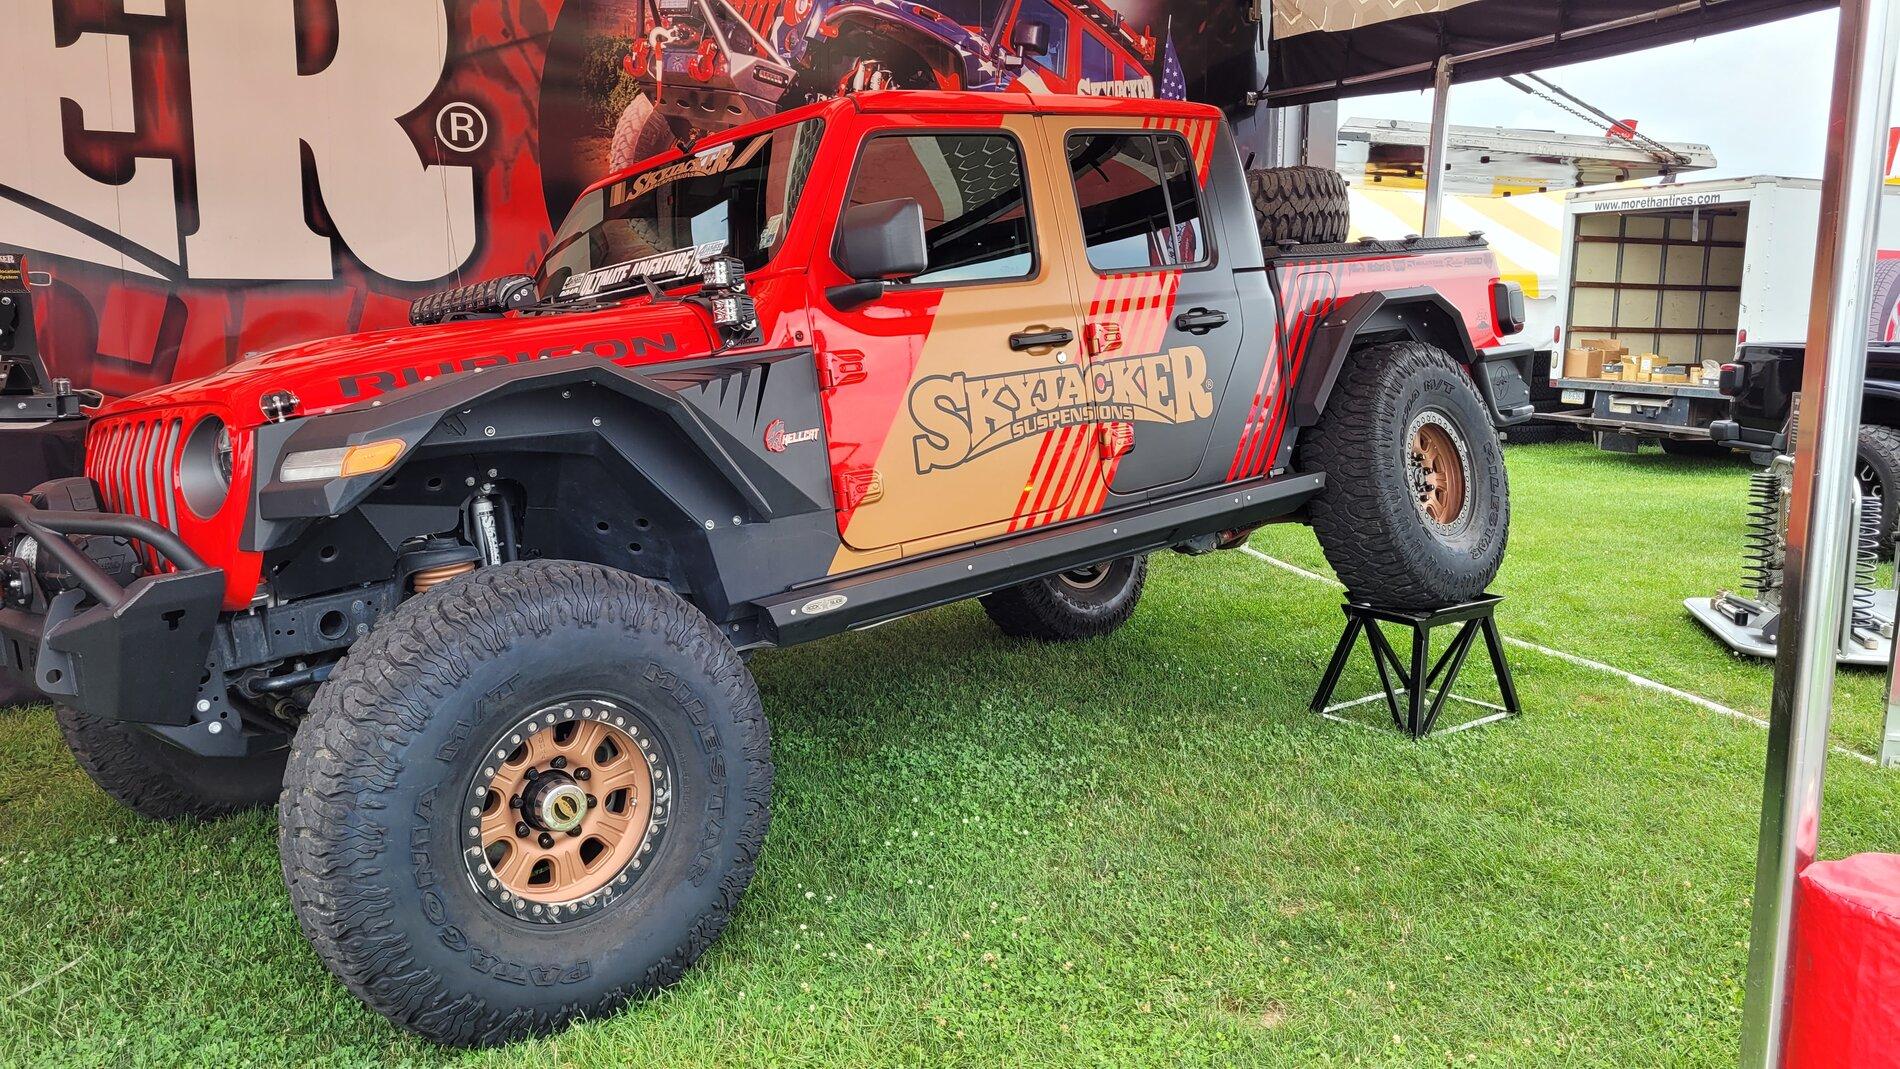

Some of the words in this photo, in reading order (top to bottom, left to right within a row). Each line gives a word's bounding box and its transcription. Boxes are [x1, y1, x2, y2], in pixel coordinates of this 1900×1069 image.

[625, 144, 736, 201] SKYJACKER
[1594, 193, 1721, 211] www.morethantires.com
[580, 264, 631, 296] ULTIMATE
[629, 249, 694, 280] ADVENTURE
[908, 345, 1213, 475] SKYJACKER
[1424, 378, 1457, 396] M/T
[782, 427, 820, 447] HELLCAT
[1012, 405, 1135, 439] SUSPENSIONS
[1470, 441, 1500, 561] MILESTAR
[436, 671, 521, 762] M/T
[643, 662, 728, 888] MILESTAR
[410, 783, 593, 987] PATAGONIA
